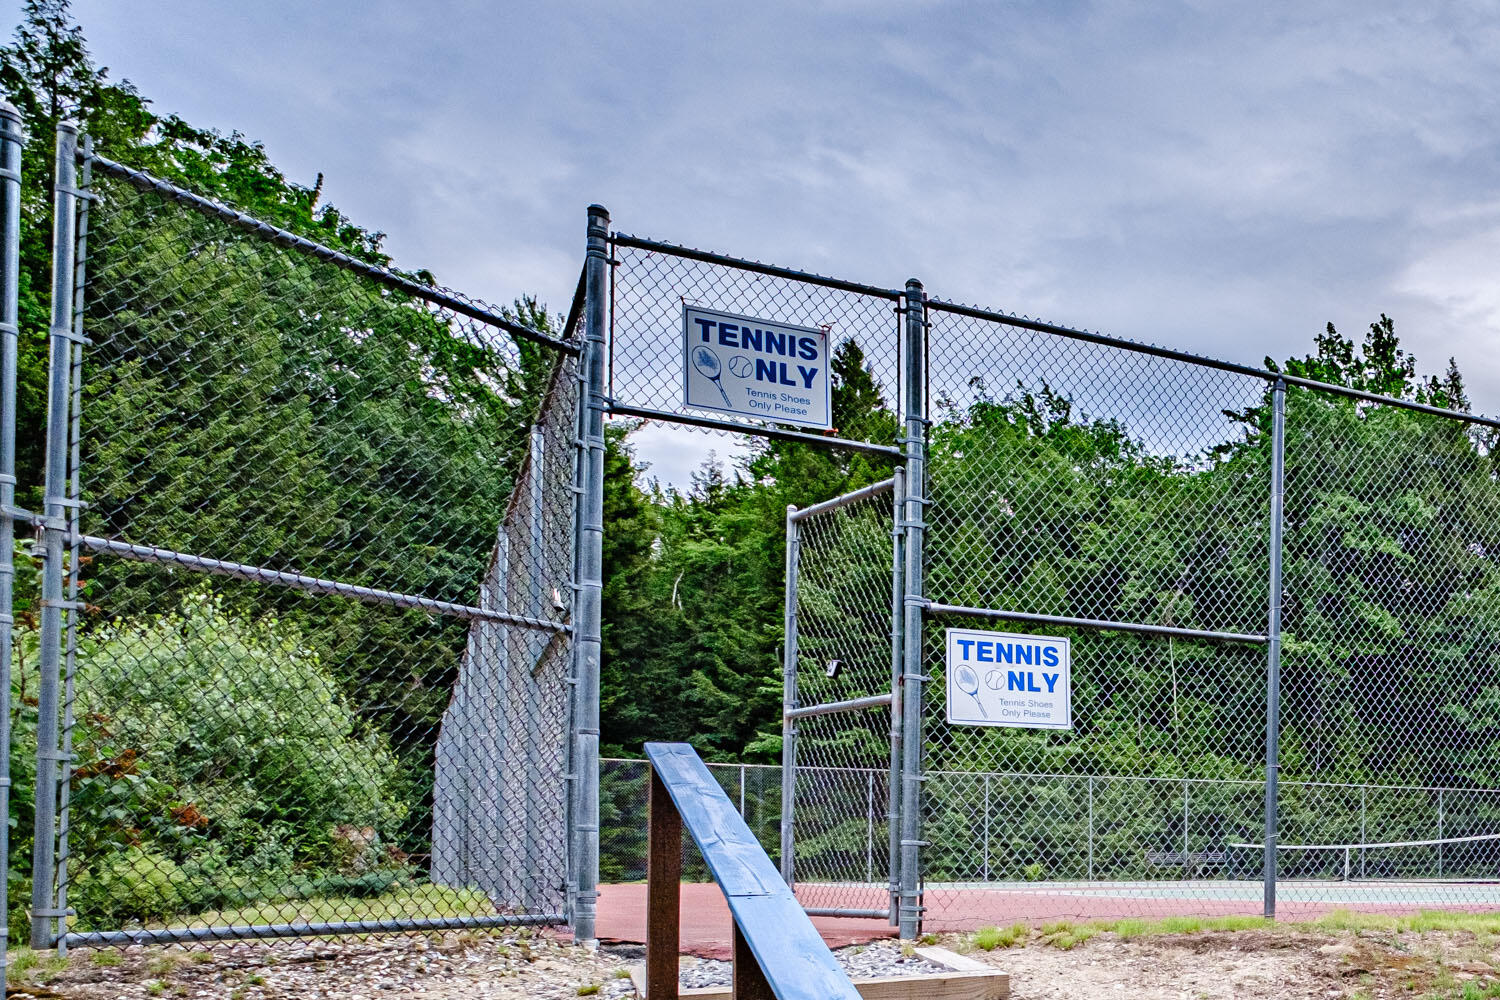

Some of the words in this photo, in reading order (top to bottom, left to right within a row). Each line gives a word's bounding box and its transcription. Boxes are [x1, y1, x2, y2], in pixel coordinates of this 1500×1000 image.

[694, 317, 818, 361] TENNIS
[746, 387, 777, 400] Tennis
[780, 393, 811, 406] Shoes
[748, 399, 772, 412] Only
[774, 403, 808, 416] Please
[957, 639, 1059, 667] TENNIS
[1000, 698, 1026, 708] Tennis
[1028, 699, 1053, 709] Shoes
[1002, 708, 1021, 718] Only
[1023, 709, 1051, 719] Please
